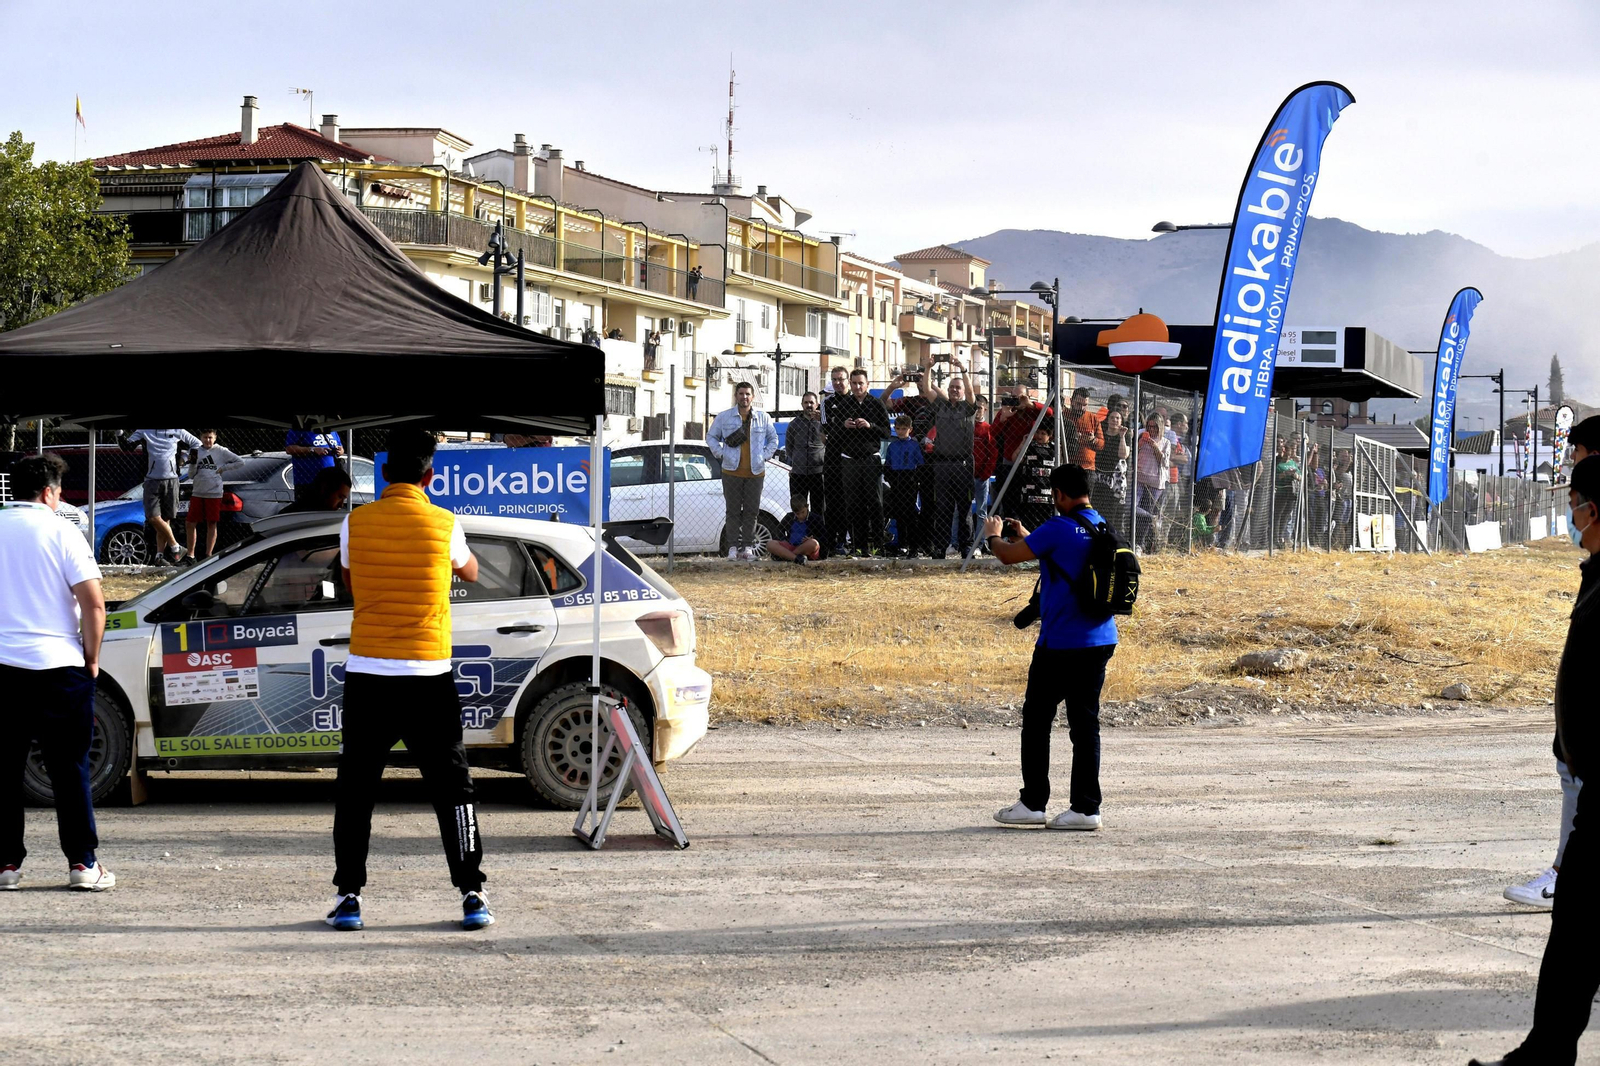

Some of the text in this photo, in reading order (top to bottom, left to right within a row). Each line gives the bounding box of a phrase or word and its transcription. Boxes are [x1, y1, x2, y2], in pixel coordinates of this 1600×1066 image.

[1217, 142, 1304, 415] radiokable
[1255, 171, 1317, 398] FIBRA. MÓVIL. PRINCIPIOS.
[1433, 321, 1460, 473] radiokable
[453, 503, 568, 515] MÓVIL. PRINCIPIOS.
[543, 557, 557, 590] 1
[603, 591, 619, 602] 85
[622, 590, 639, 600] 78
[641, 589, 658, 600] 26
[173, 623, 188, 652] 1
[159, 734, 341, 752] EL SOL SALE TODOS LOS
